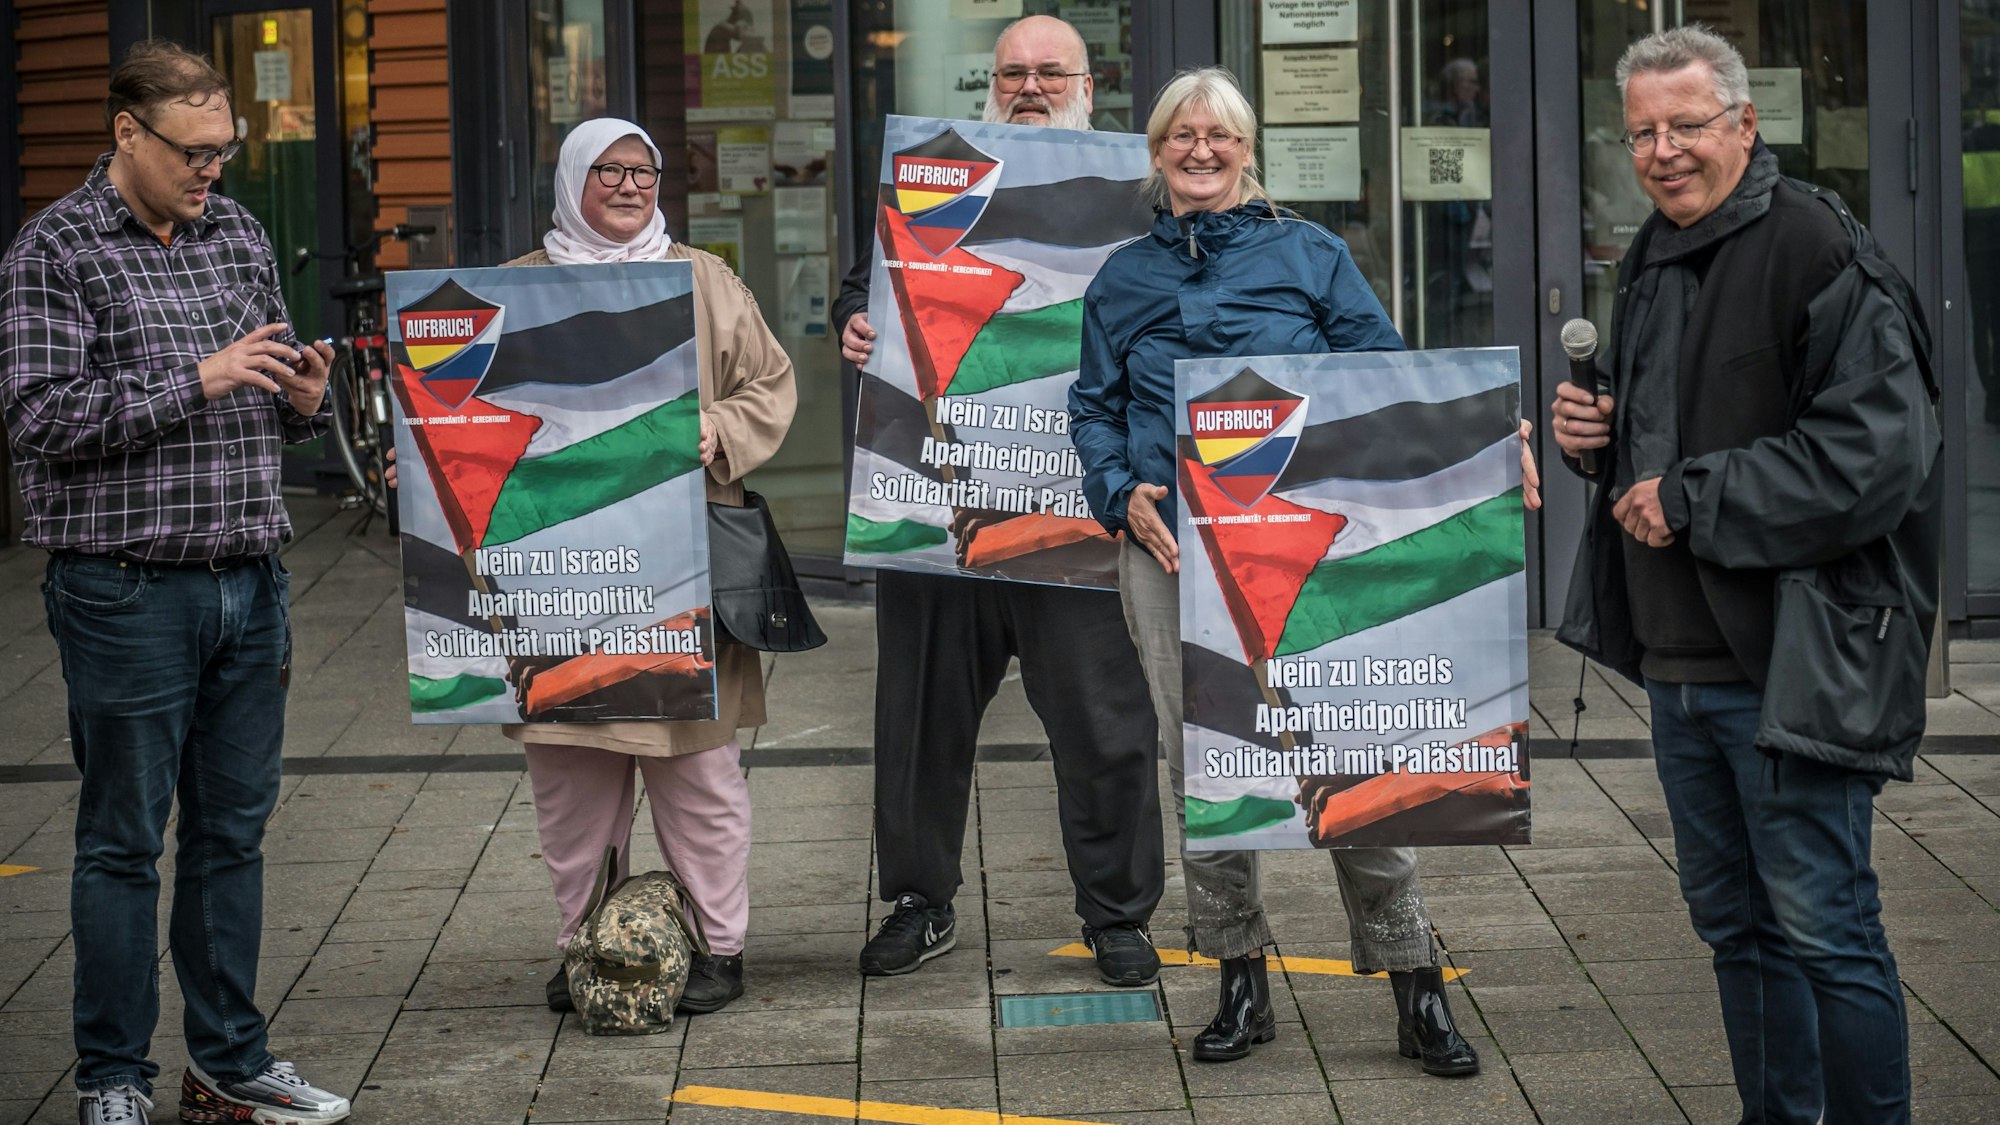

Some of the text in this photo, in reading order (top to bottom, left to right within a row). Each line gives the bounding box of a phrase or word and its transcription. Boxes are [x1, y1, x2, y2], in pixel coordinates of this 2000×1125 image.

[1269, 1, 1298, 10] Vorlage
[1301, 0, 1315, 8] des
[1279, 10, 1339, 19] Nationalpasses
[1293, 20, 1326, 29] möglich
[712, 53, 768, 79] ASS
[898, 163, 969, 187] AUFBRUCH
[881, 260, 904, 268] FRIEDEN
[406, 317, 474, 338] AUFBRUCH
[936, 397, 1072, 435] Nein zu Isra
[1196, 409, 1273, 431] AUFBRUCH
[920, 436, 1087, 478] Apartheidpolit
[870, 472, 1095, 519] Solidarität mit Palä
[1188, 516, 1213, 525] FRIEDEN
[474, 545, 640, 576] Nein zu Israels
[468, 586, 655, 620] Apartheidpolitik!
[426, 625, 702, 658] Solidarität mit Palästina!
[1266, 654, 1454, 688] Nein zu Israels
[1255, 698, 1467, 736] Apartheidpolitik!
[1205, 741, 1520, 778] Solidarität mit Palästina!
